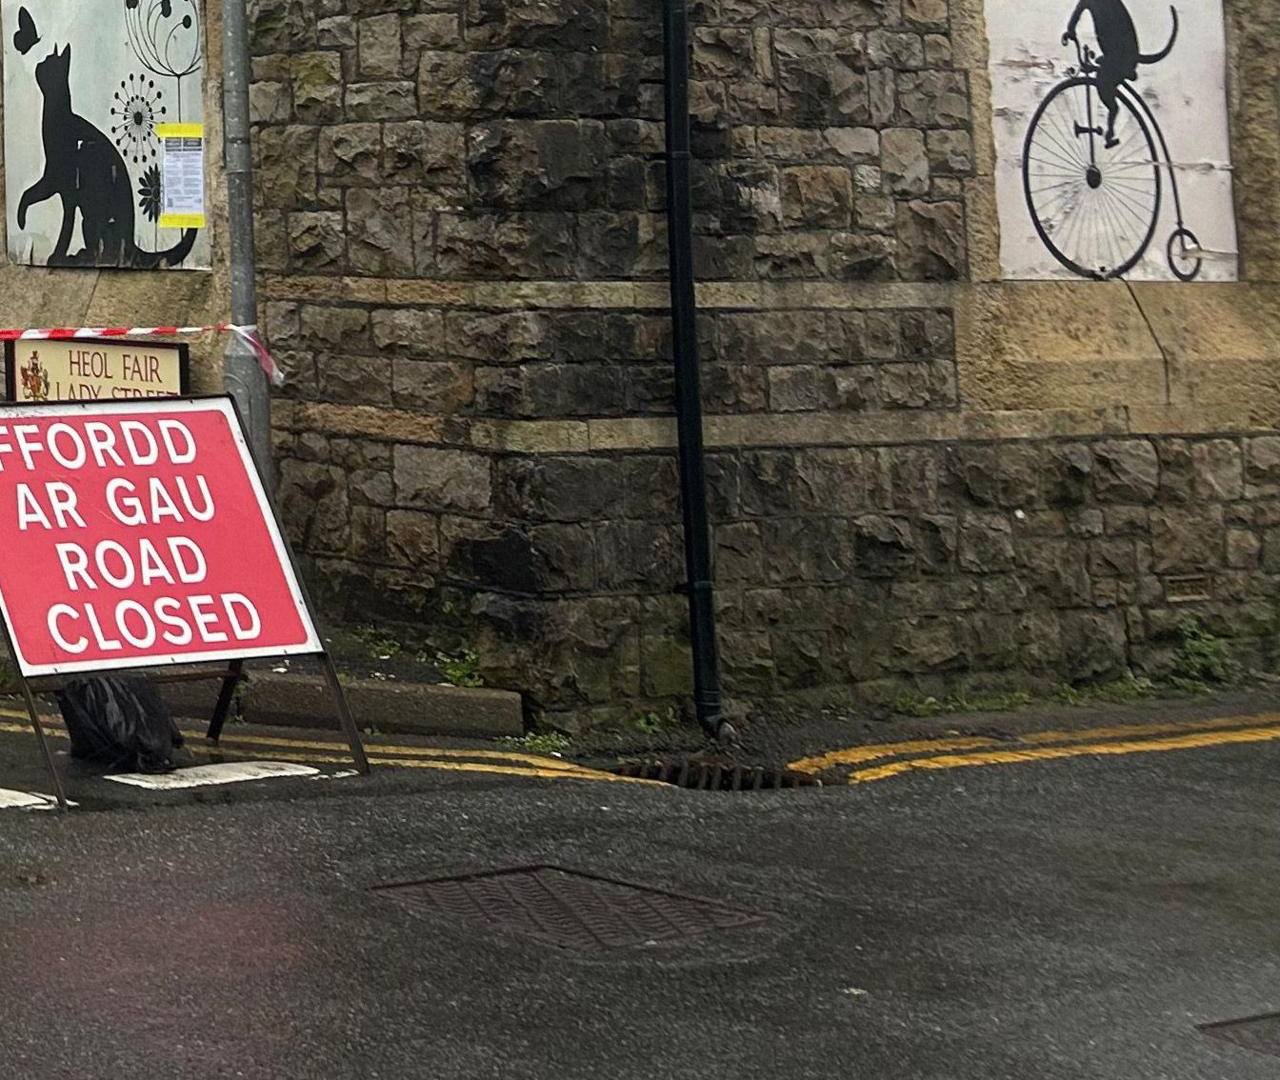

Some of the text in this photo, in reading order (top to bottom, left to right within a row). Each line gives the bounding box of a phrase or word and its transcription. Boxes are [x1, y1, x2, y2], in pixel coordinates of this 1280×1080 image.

[68, 349, 163, 383] HEOL FAIR
[16, 475, 216, 531] AR GAU
[55, 536, 209, 591] ROAD
[46, 592, 262, 654] CLOSED
